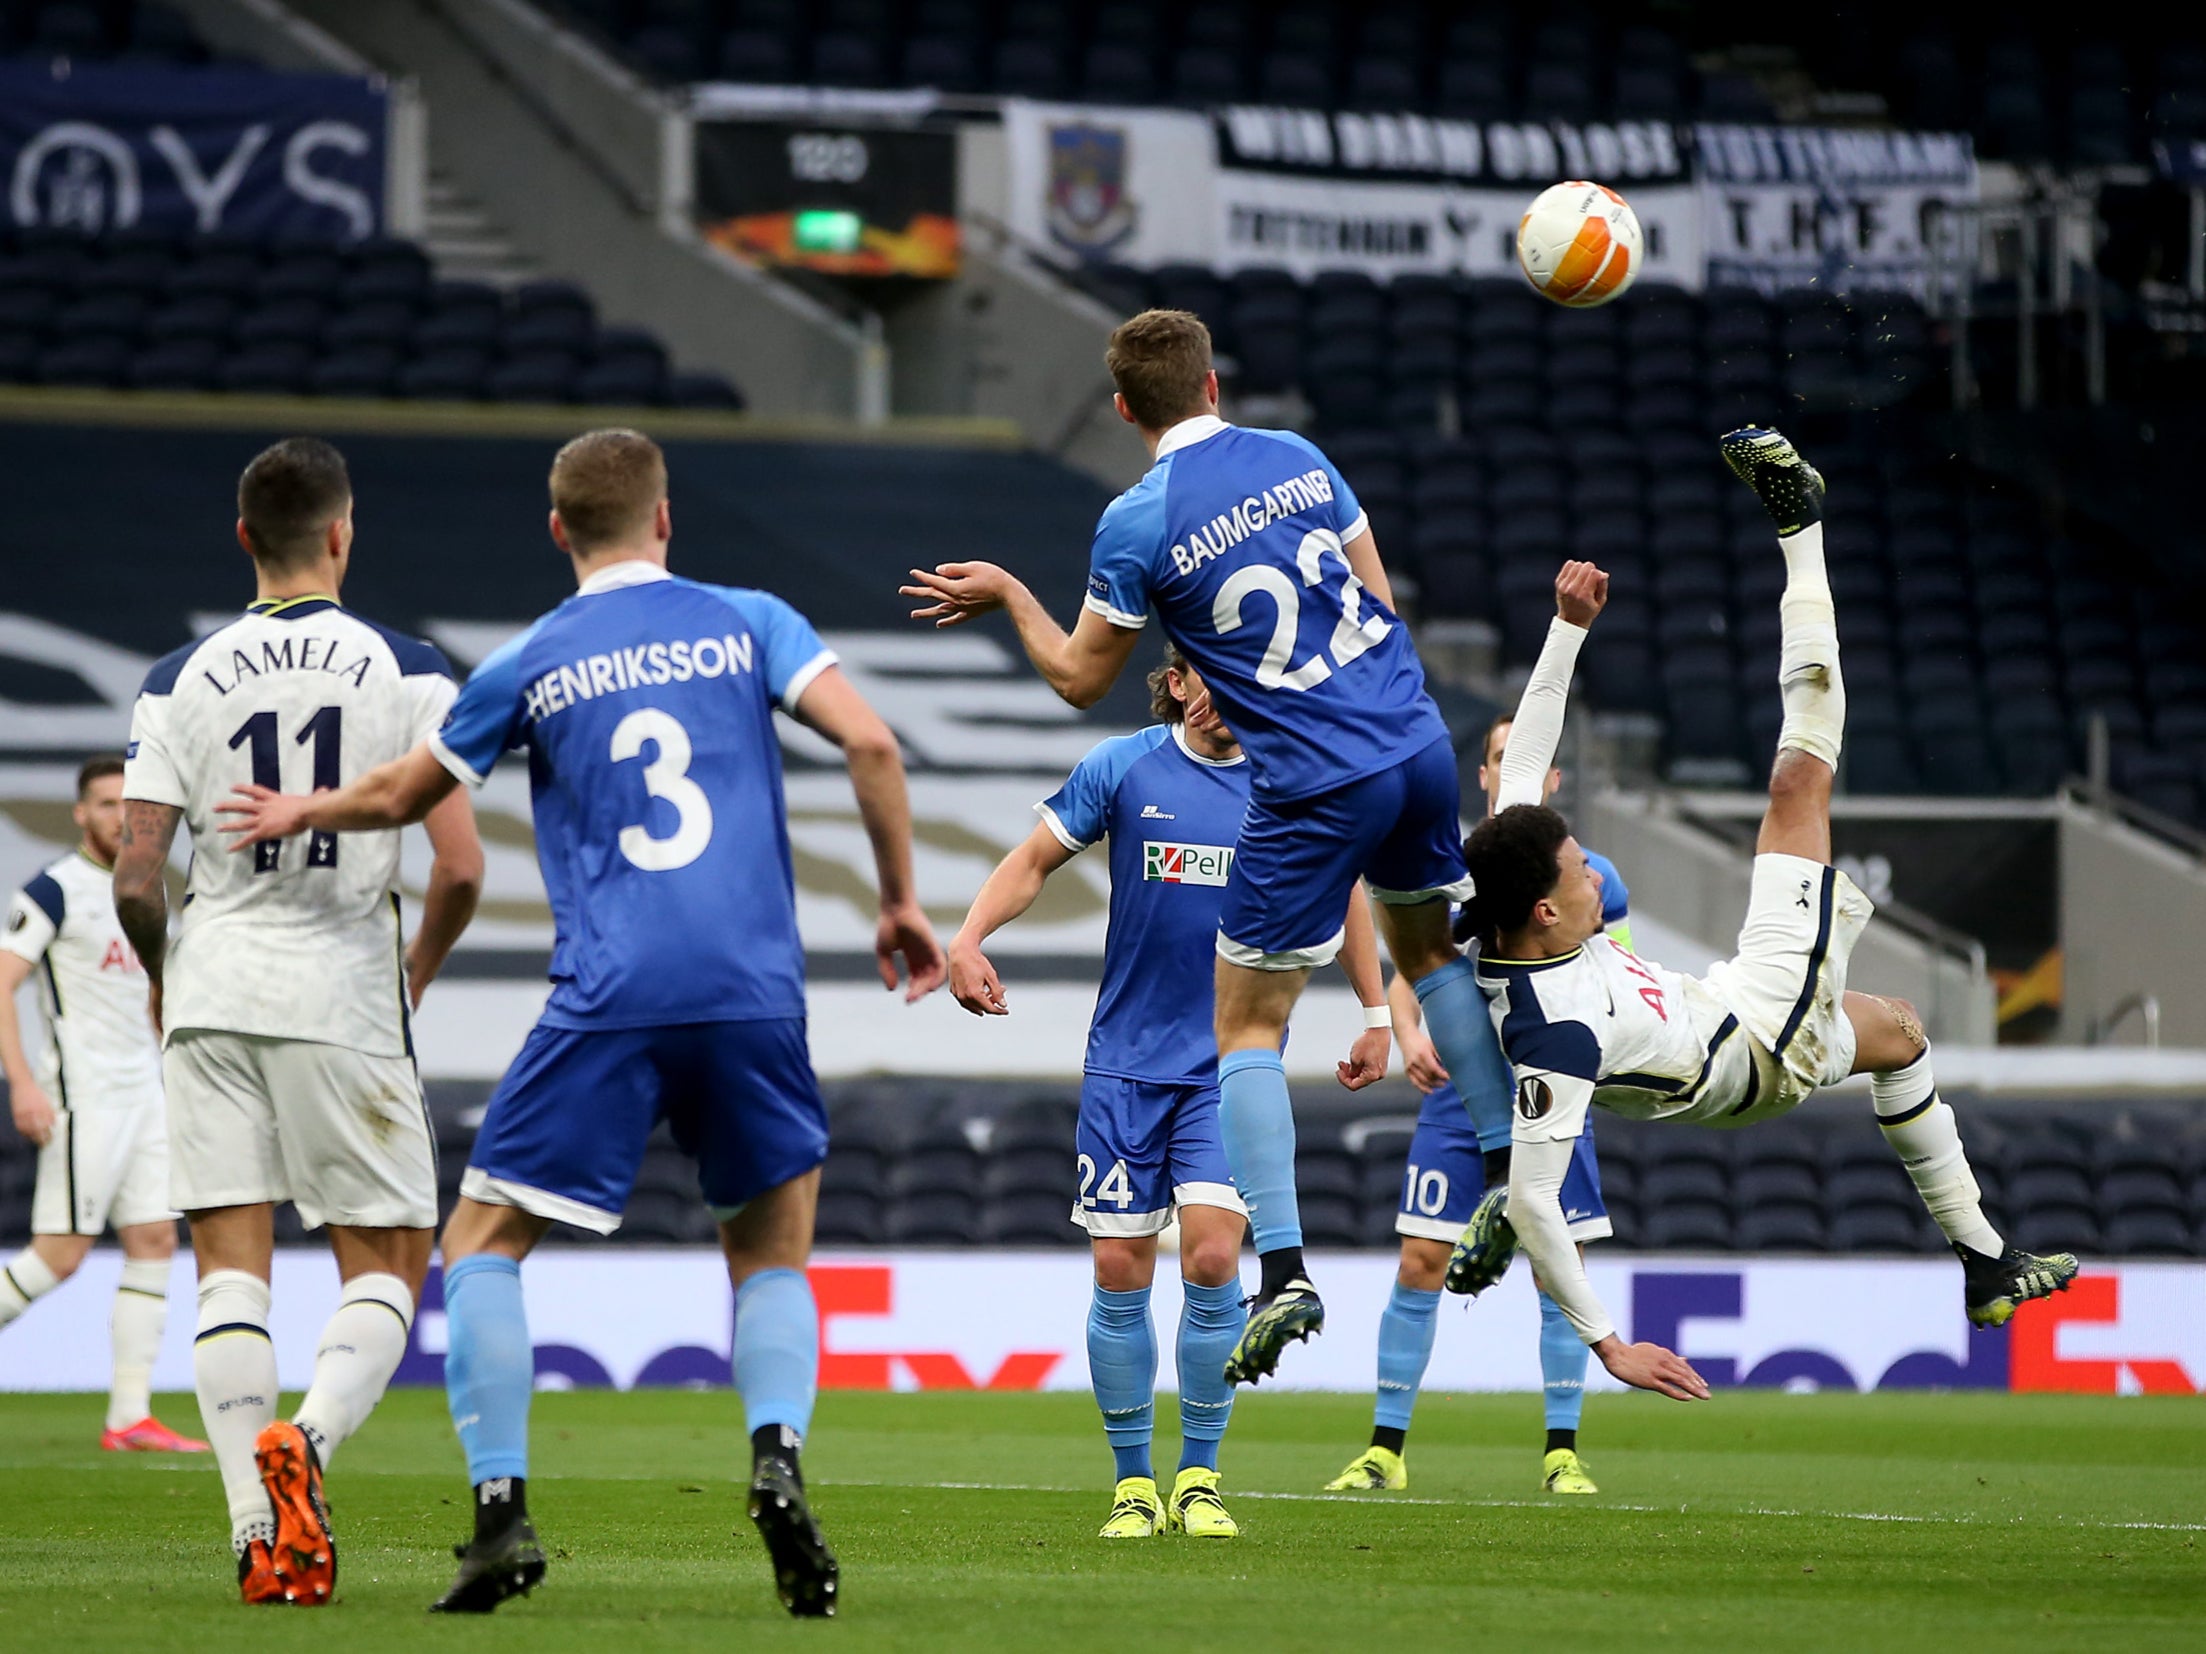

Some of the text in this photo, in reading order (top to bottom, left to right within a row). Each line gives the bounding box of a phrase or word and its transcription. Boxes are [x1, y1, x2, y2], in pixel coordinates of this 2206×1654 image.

[1212, 528, 1393, 692] 22
[203, 637, 372, 696] LAMELA
[525, 631, 753, 722] HENRIKSSON
[227, 706, 343, 874] 11
[610, 707, 714, 872] 3
[1077, 1153, 1133, 1209] 24
[1406, 1164, 1449, 1217] 10
[217, 1396, 264, 1414] SPURS
